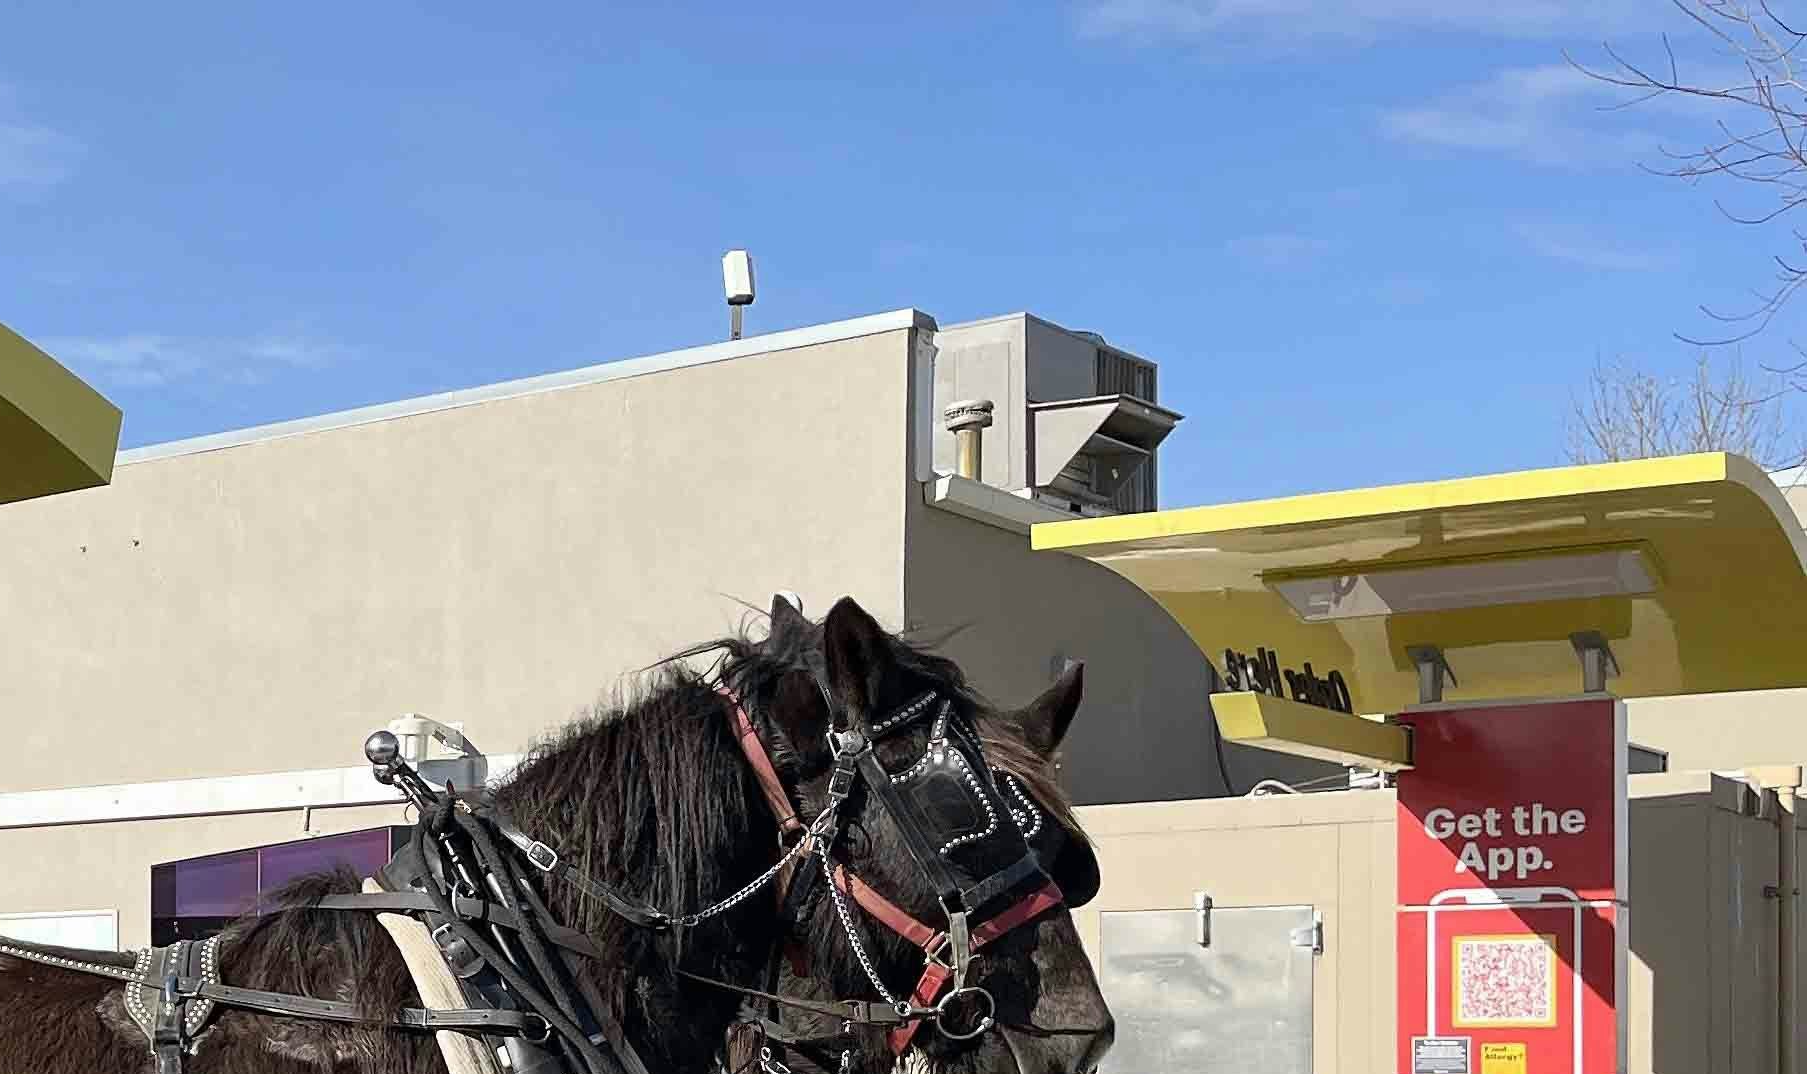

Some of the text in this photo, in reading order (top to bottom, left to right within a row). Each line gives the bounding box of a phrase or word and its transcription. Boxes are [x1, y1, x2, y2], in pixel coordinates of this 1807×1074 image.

[1424, 803, 1586, 840] Get the
[1455, 842, 1553, 880] App.
